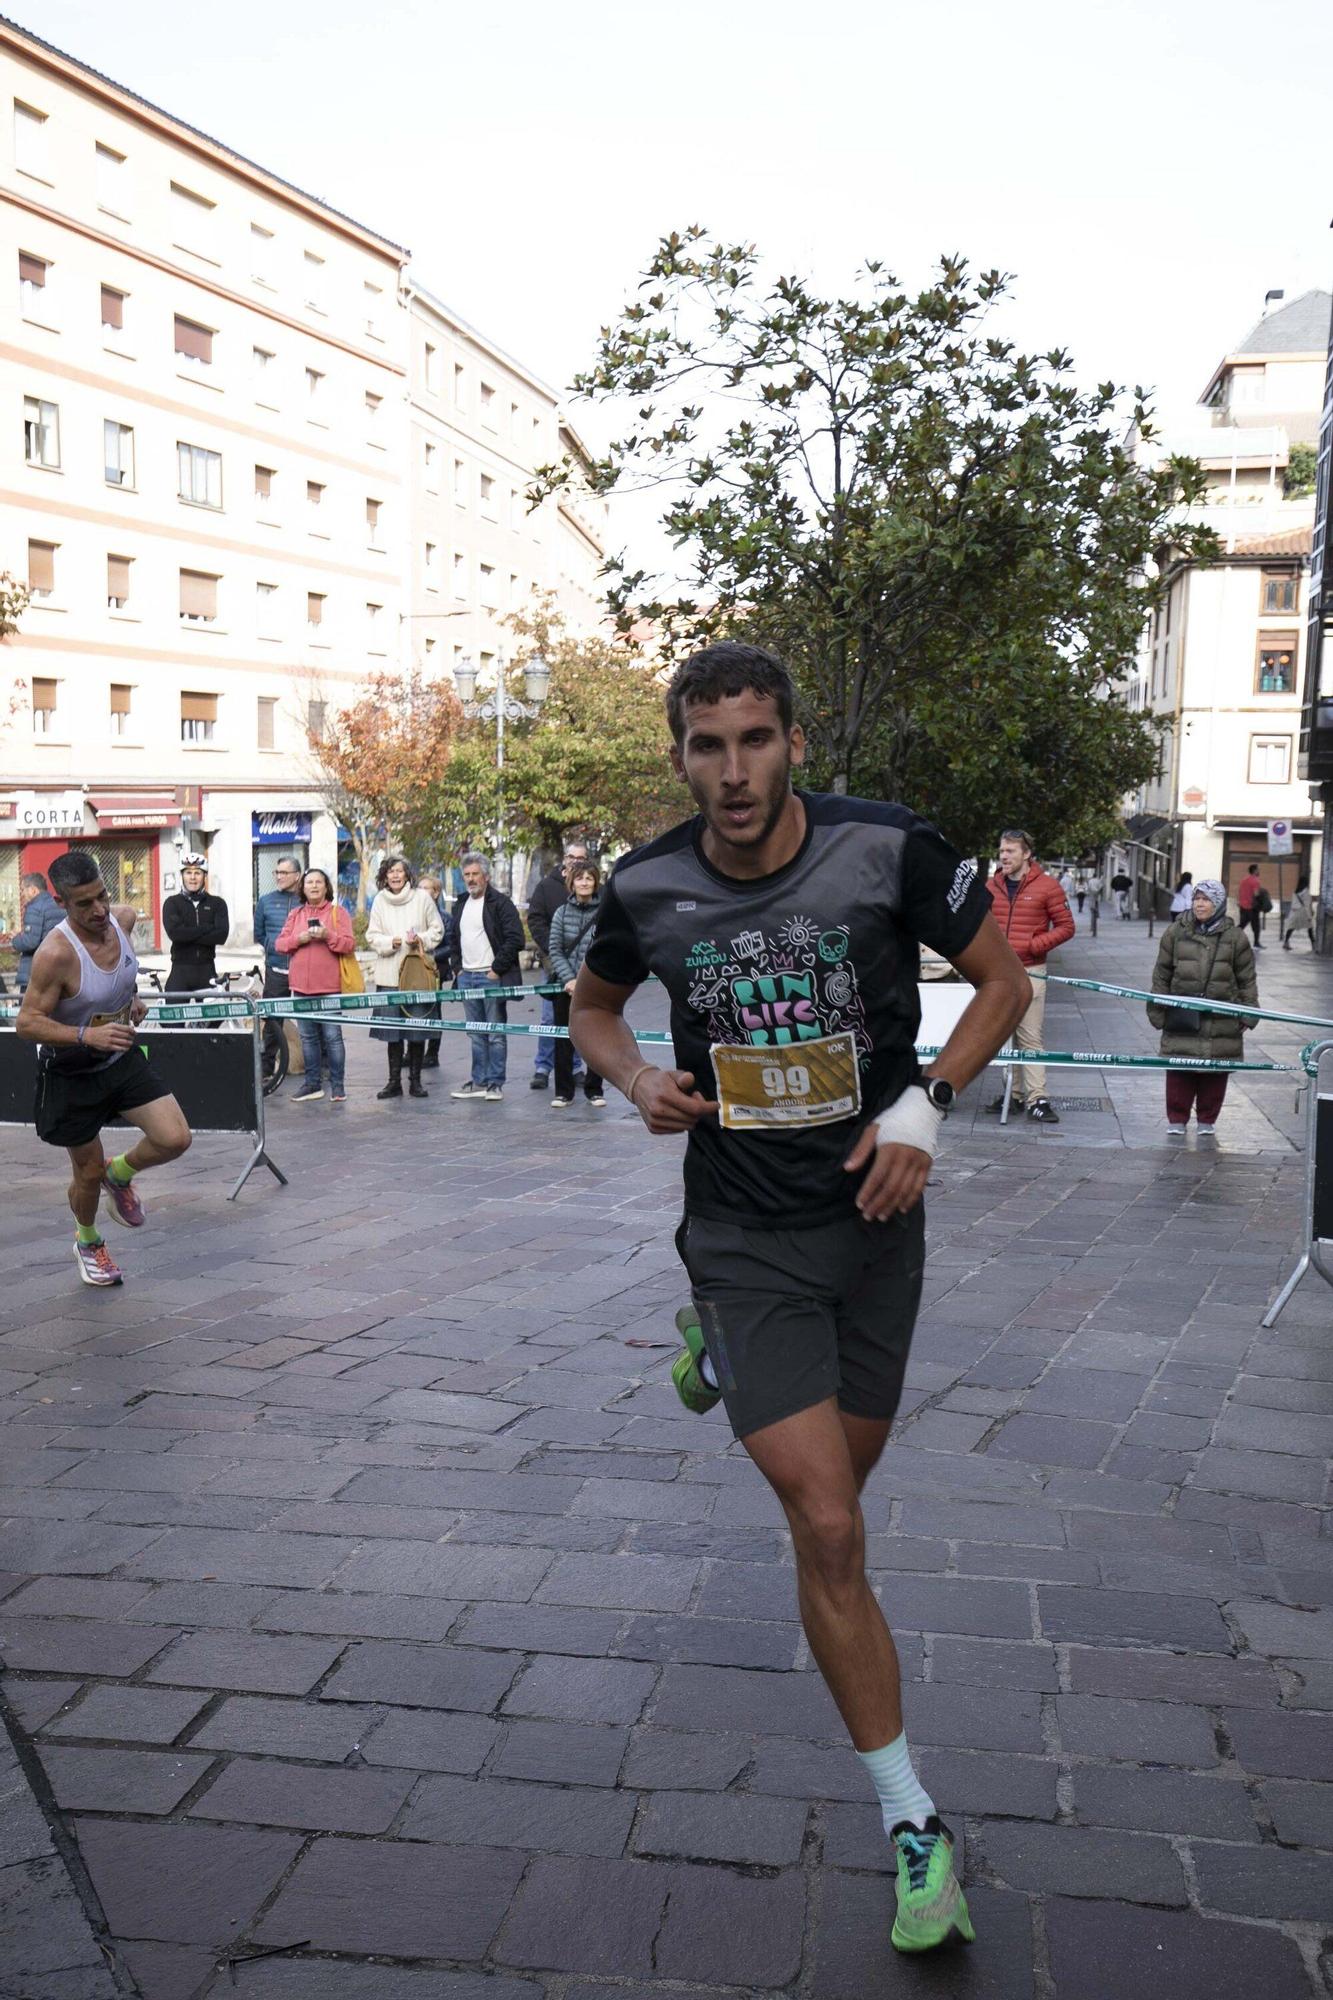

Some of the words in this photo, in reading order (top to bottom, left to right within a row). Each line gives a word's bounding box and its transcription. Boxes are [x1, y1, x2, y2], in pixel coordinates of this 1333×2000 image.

[24, 810, 82, 825] CORTA
[112, 816, 131, 826] CAVA
[734, 974, 811, 1005] RUN
[742, 1000, 816, 1029] LIKE
[828, 1042, 845, 1054] 10K
[1073, 1052, 1105, 1062] GASTEIZ
[762, 1066, 811, 1097] 99
